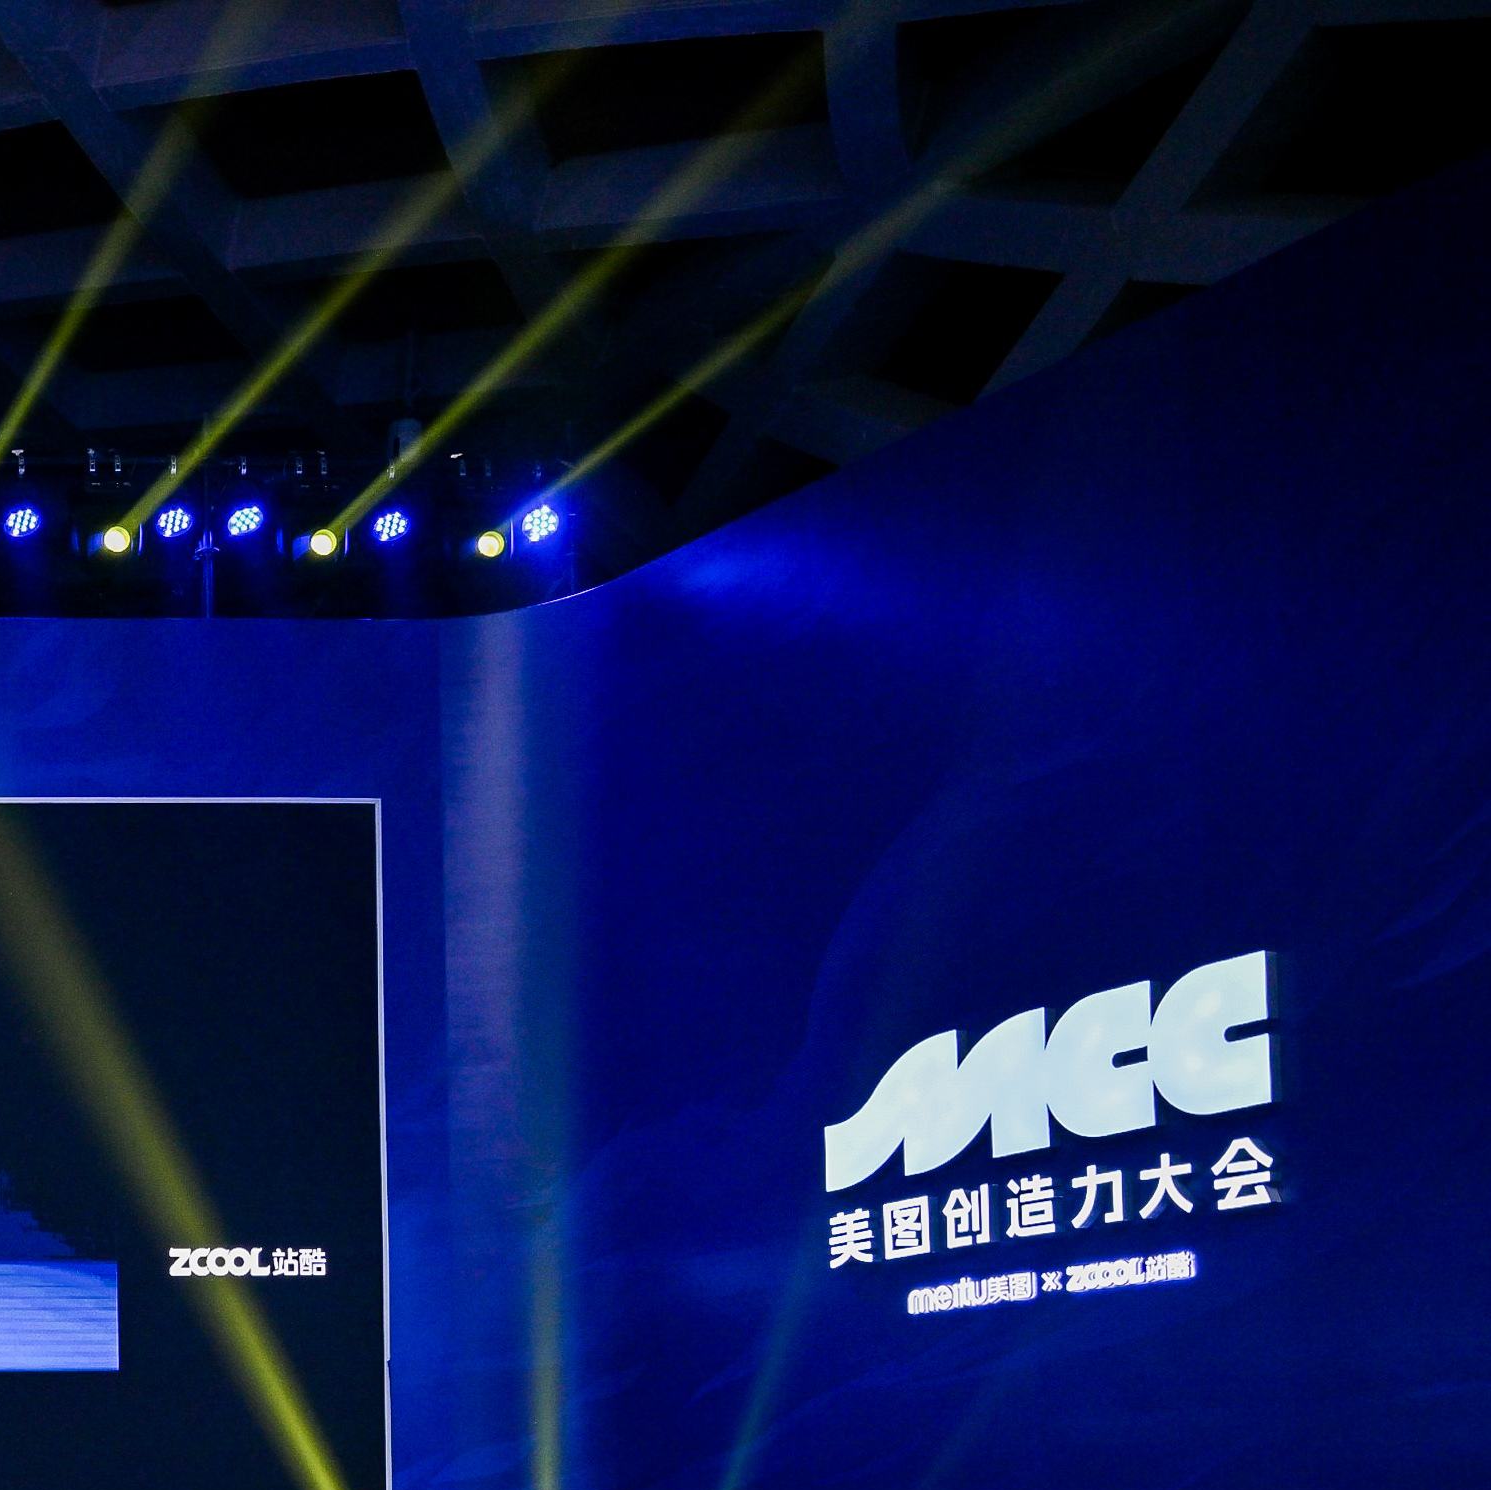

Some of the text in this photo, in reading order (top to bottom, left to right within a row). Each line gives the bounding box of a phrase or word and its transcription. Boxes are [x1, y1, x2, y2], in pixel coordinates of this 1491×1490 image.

[828, 1136, 1274, 1269] 美图创造力大会
